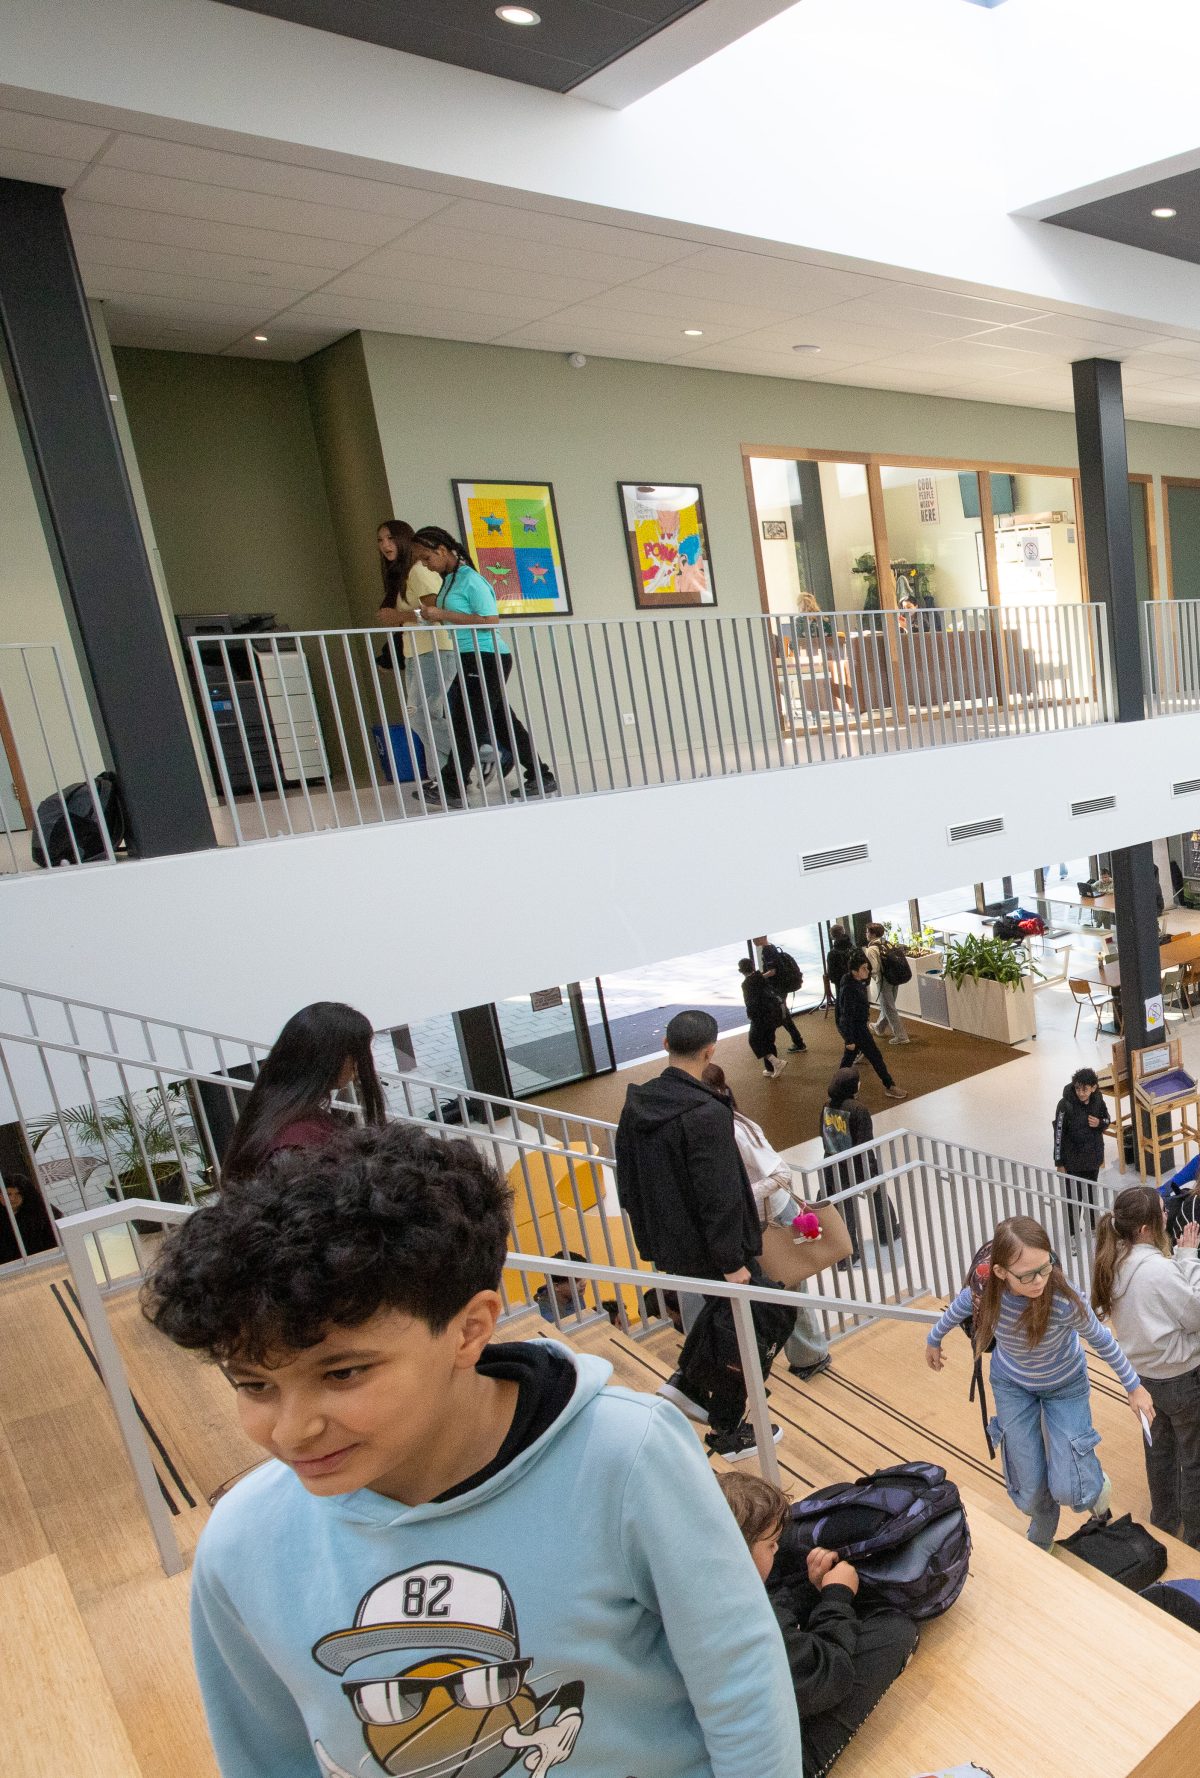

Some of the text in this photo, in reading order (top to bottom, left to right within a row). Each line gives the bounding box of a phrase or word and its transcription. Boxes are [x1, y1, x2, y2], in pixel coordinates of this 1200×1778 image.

[918, 478, 933, 491] COOL
[919, 490, 935, 500] PEOPLE
[921, 508, 936, 522] HERE
[402, 1573, 454, 1618] 82
